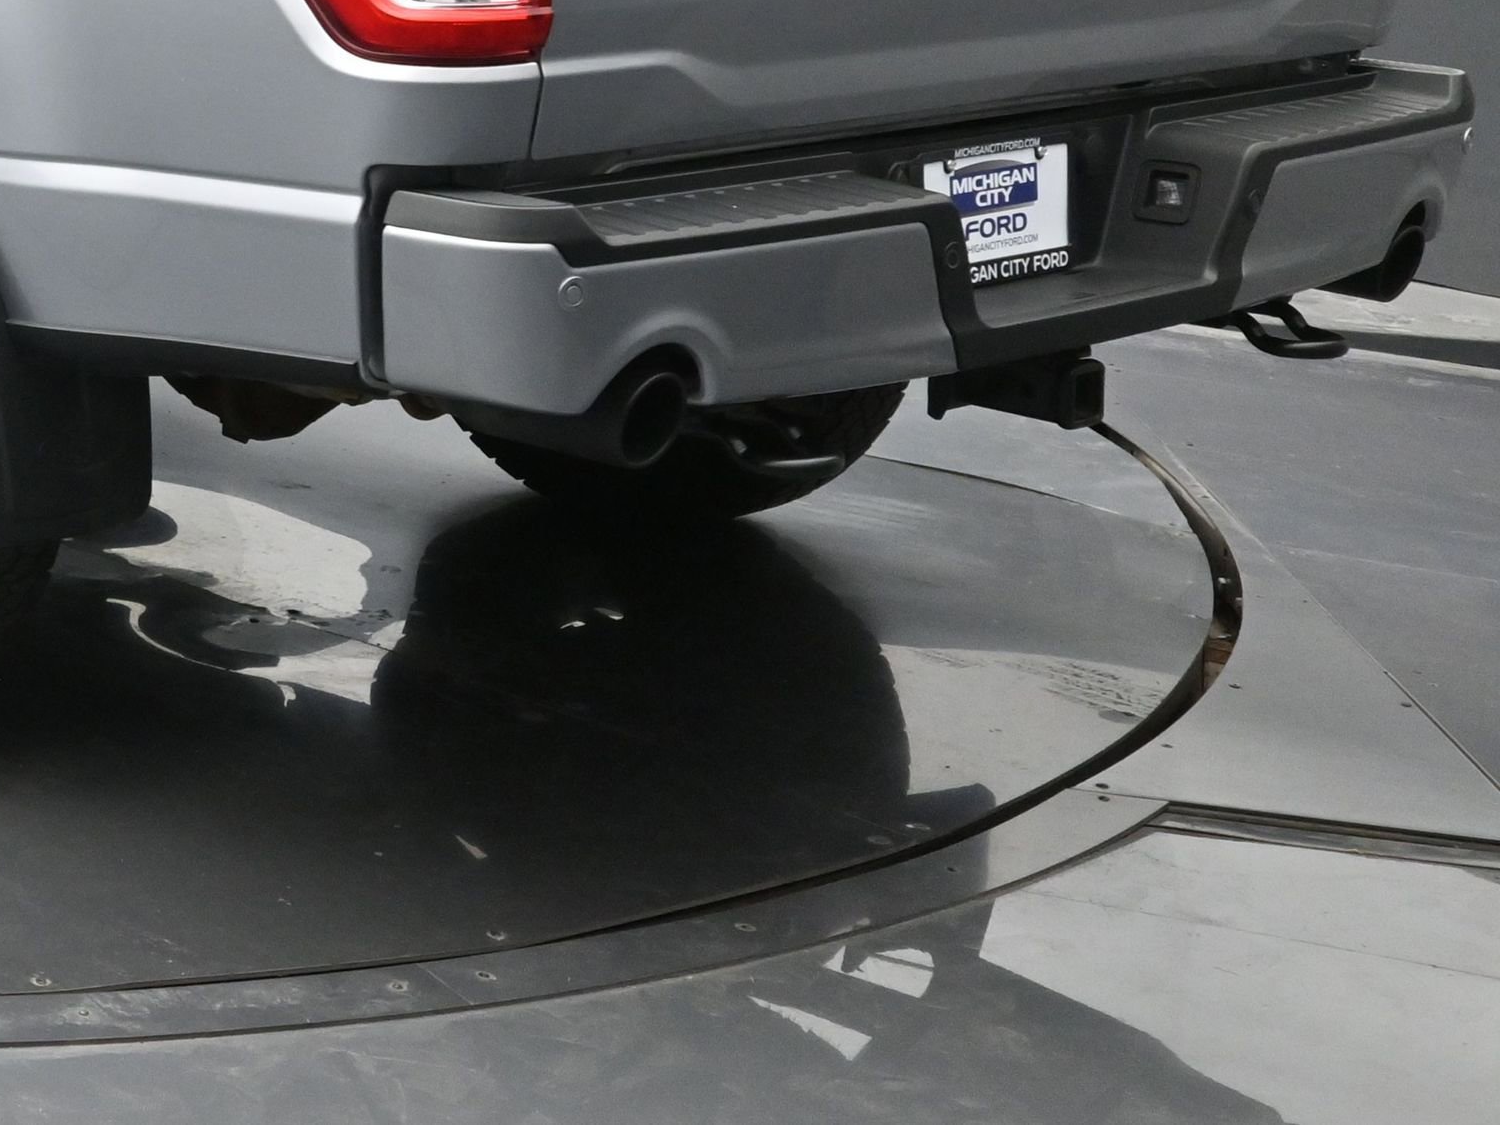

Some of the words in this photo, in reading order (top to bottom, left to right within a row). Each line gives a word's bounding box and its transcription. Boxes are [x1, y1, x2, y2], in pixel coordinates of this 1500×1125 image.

[954, 137, 1041, 159] MICHIGANCITYFORD.COM
[952, 166, 1035, 196] MICHIGAN
[975, 186, 1013, 208] CITY
[965, 213, 1028, 241] FORD
[967, 233, 1039, 254] HIGANCITYFORD.COM
[1001, 257, 1030, 278] CITY
[1033, 251, 1069, 272] FORD
